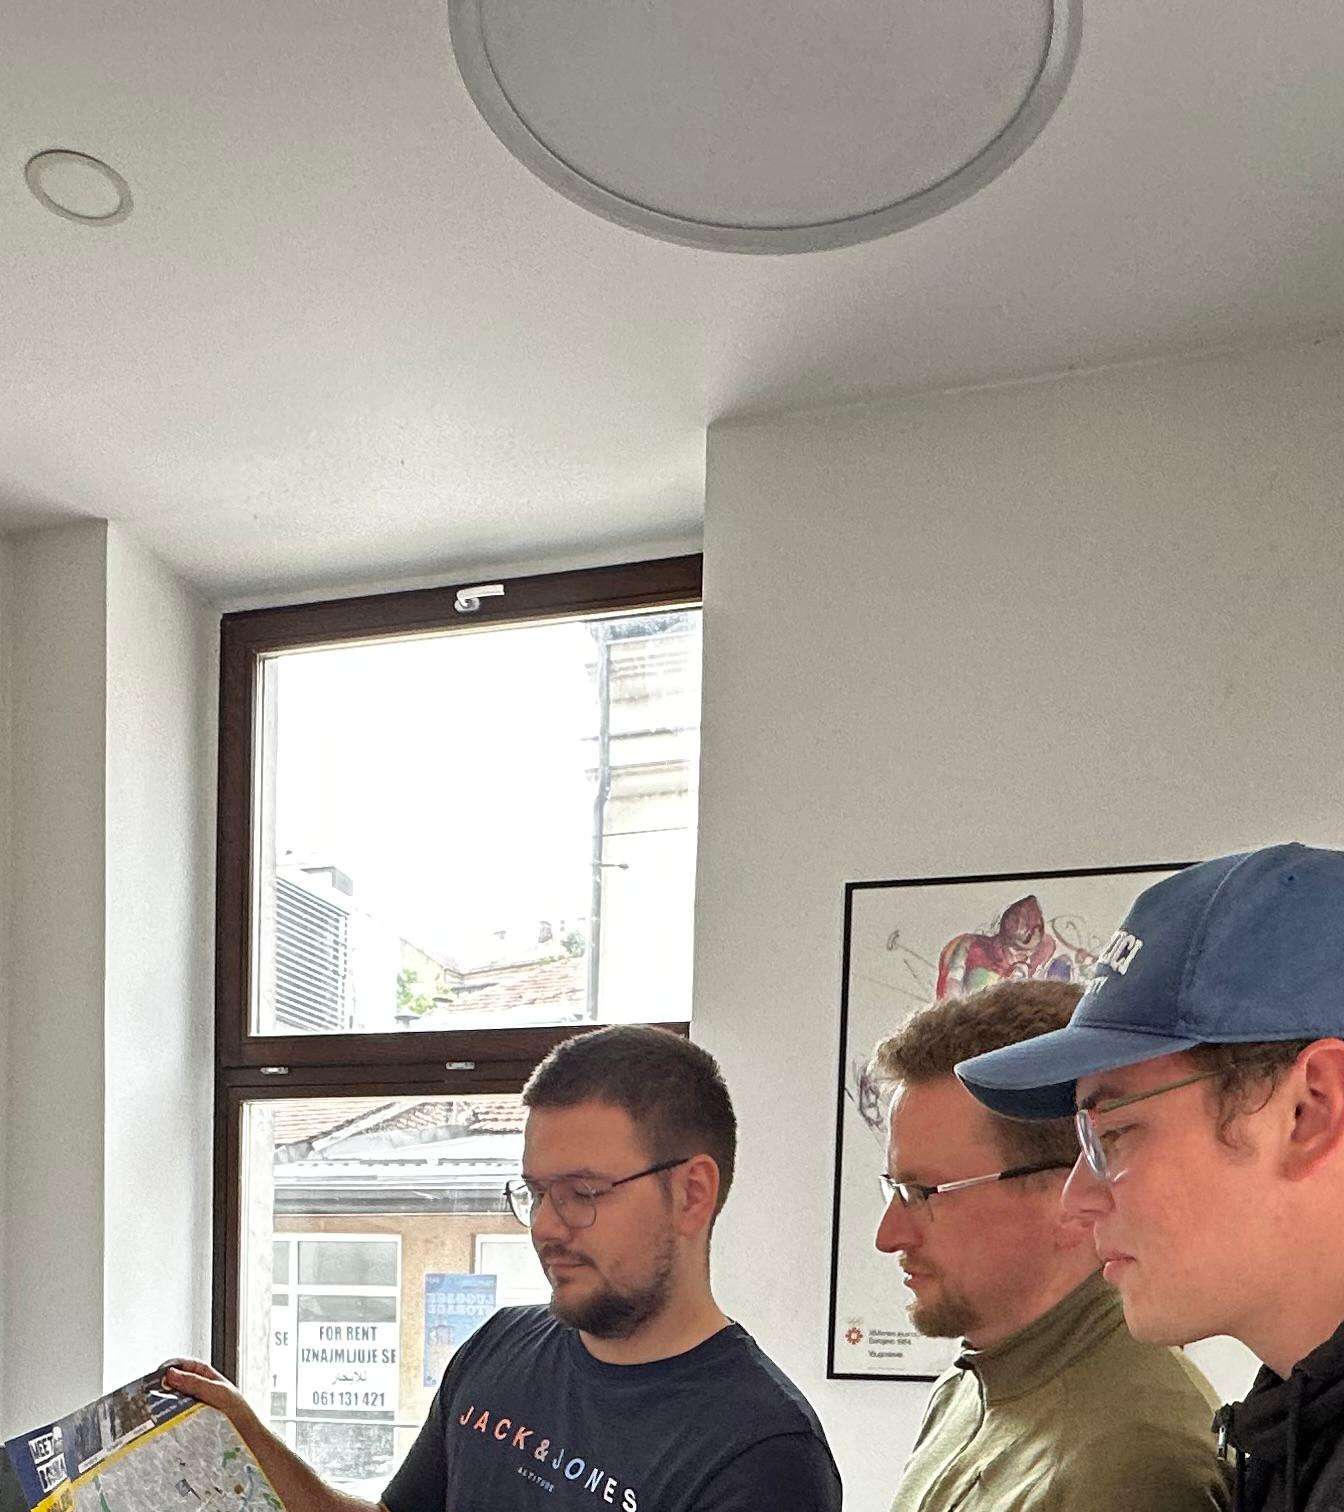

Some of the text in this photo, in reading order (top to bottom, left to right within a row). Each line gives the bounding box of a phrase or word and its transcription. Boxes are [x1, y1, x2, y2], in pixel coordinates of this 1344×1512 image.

[319, 1326, 378, 1341] FOR RENT
[301, 1348, 397, 1364] IZNAJMLJUJE SE
[312, 1391, 385, 1407] 061 131 421
